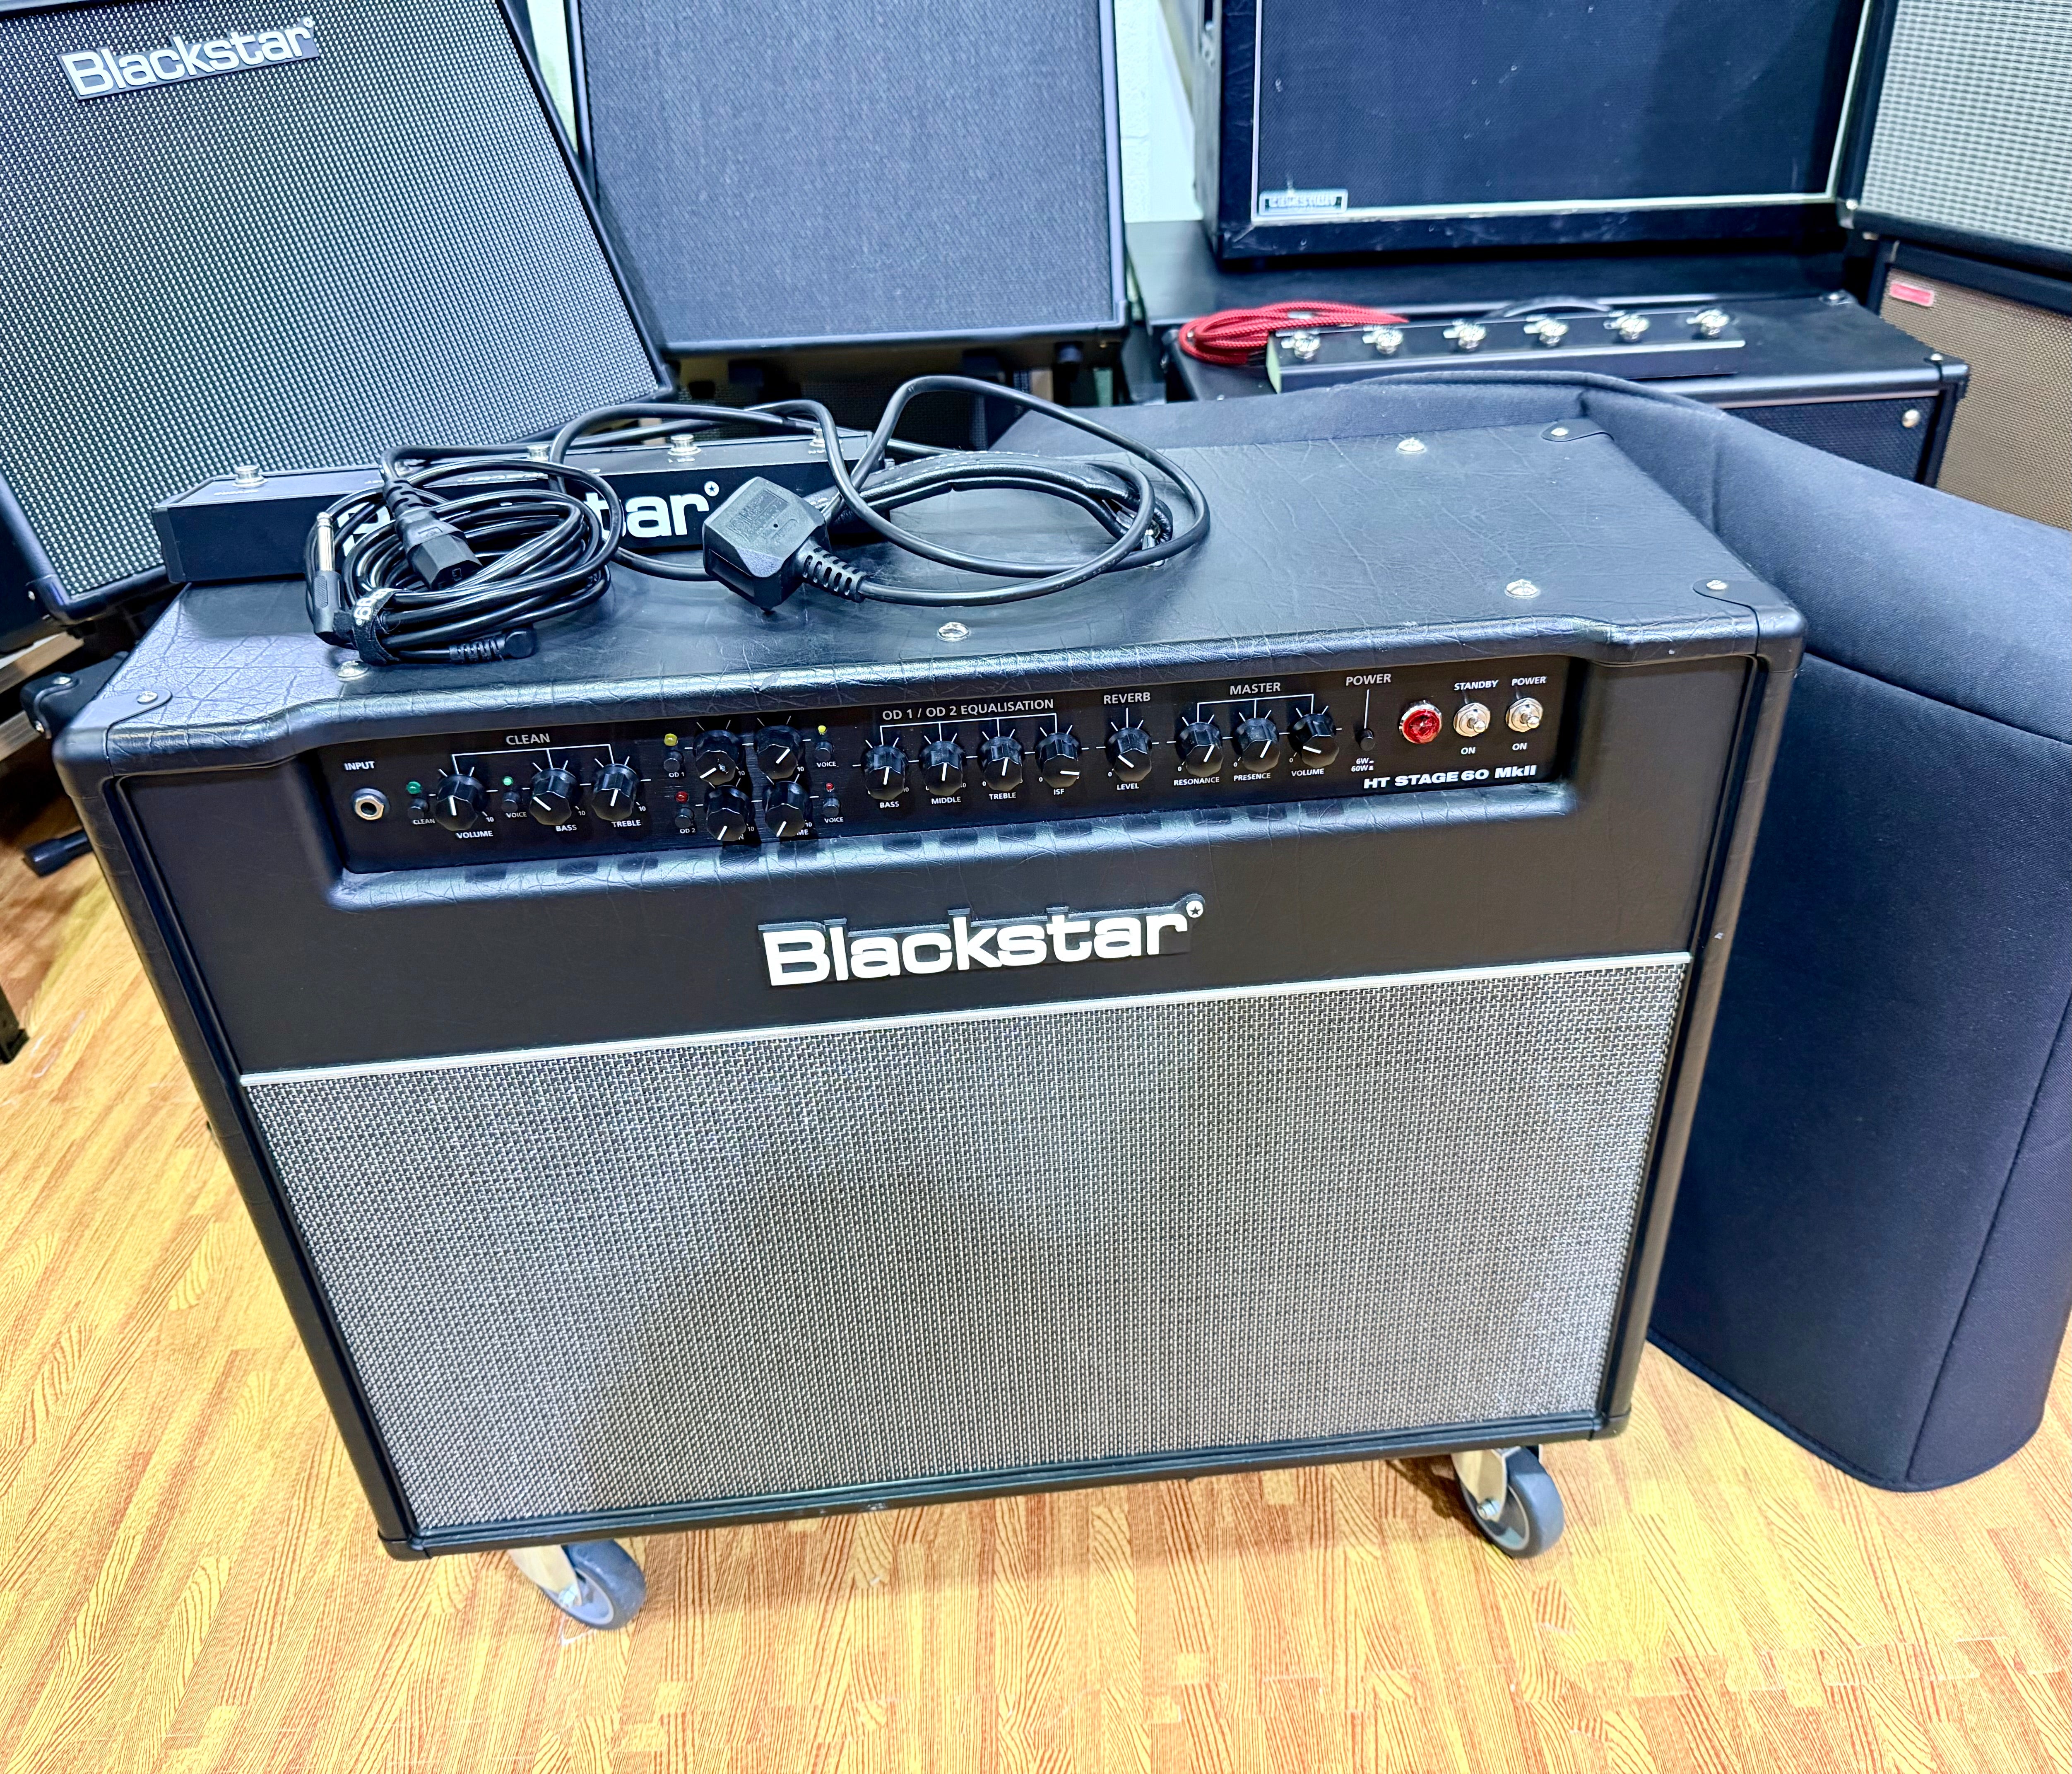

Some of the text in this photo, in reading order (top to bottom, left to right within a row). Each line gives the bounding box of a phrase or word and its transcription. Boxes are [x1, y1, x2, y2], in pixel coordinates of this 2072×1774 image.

[61, 26, 311, 96] Blackstar
[1346, 674, 1391, 686] POWER
[1512, 676, 1546, 686] POWER
[1230, 682, 1280, 695] MASTER
[1454, 680, 1499, 690] STANDBY
[1104, 692, 1150, 704] REVERB
[883, 699, 1054, 720] OD 1 / OD 2 EQUALISATION
[506, 733, 550, 745] CLEAN
[1461, 747, 1476, 755] ON
[1512, 742, 1527, 751] ON
[344, 761, 375, 770] INPUT
[1291, 768, 1324, 776] VOLUME
[1364, 765, 1536, 788] HT STAGE 60 MkII
[1174, 777, 1219, 786] RESONANCE
[1234, 773, 1271, 781] PRESENCE
[931, 796, 961, 805] MIDDLE
[989, 792, 1016, 800] TREBLE
[611, 820, 642, 828] TREBLE
[456, 830, 493, 839] VOLUME
[763, 913, 1189, 986] Blackstar
